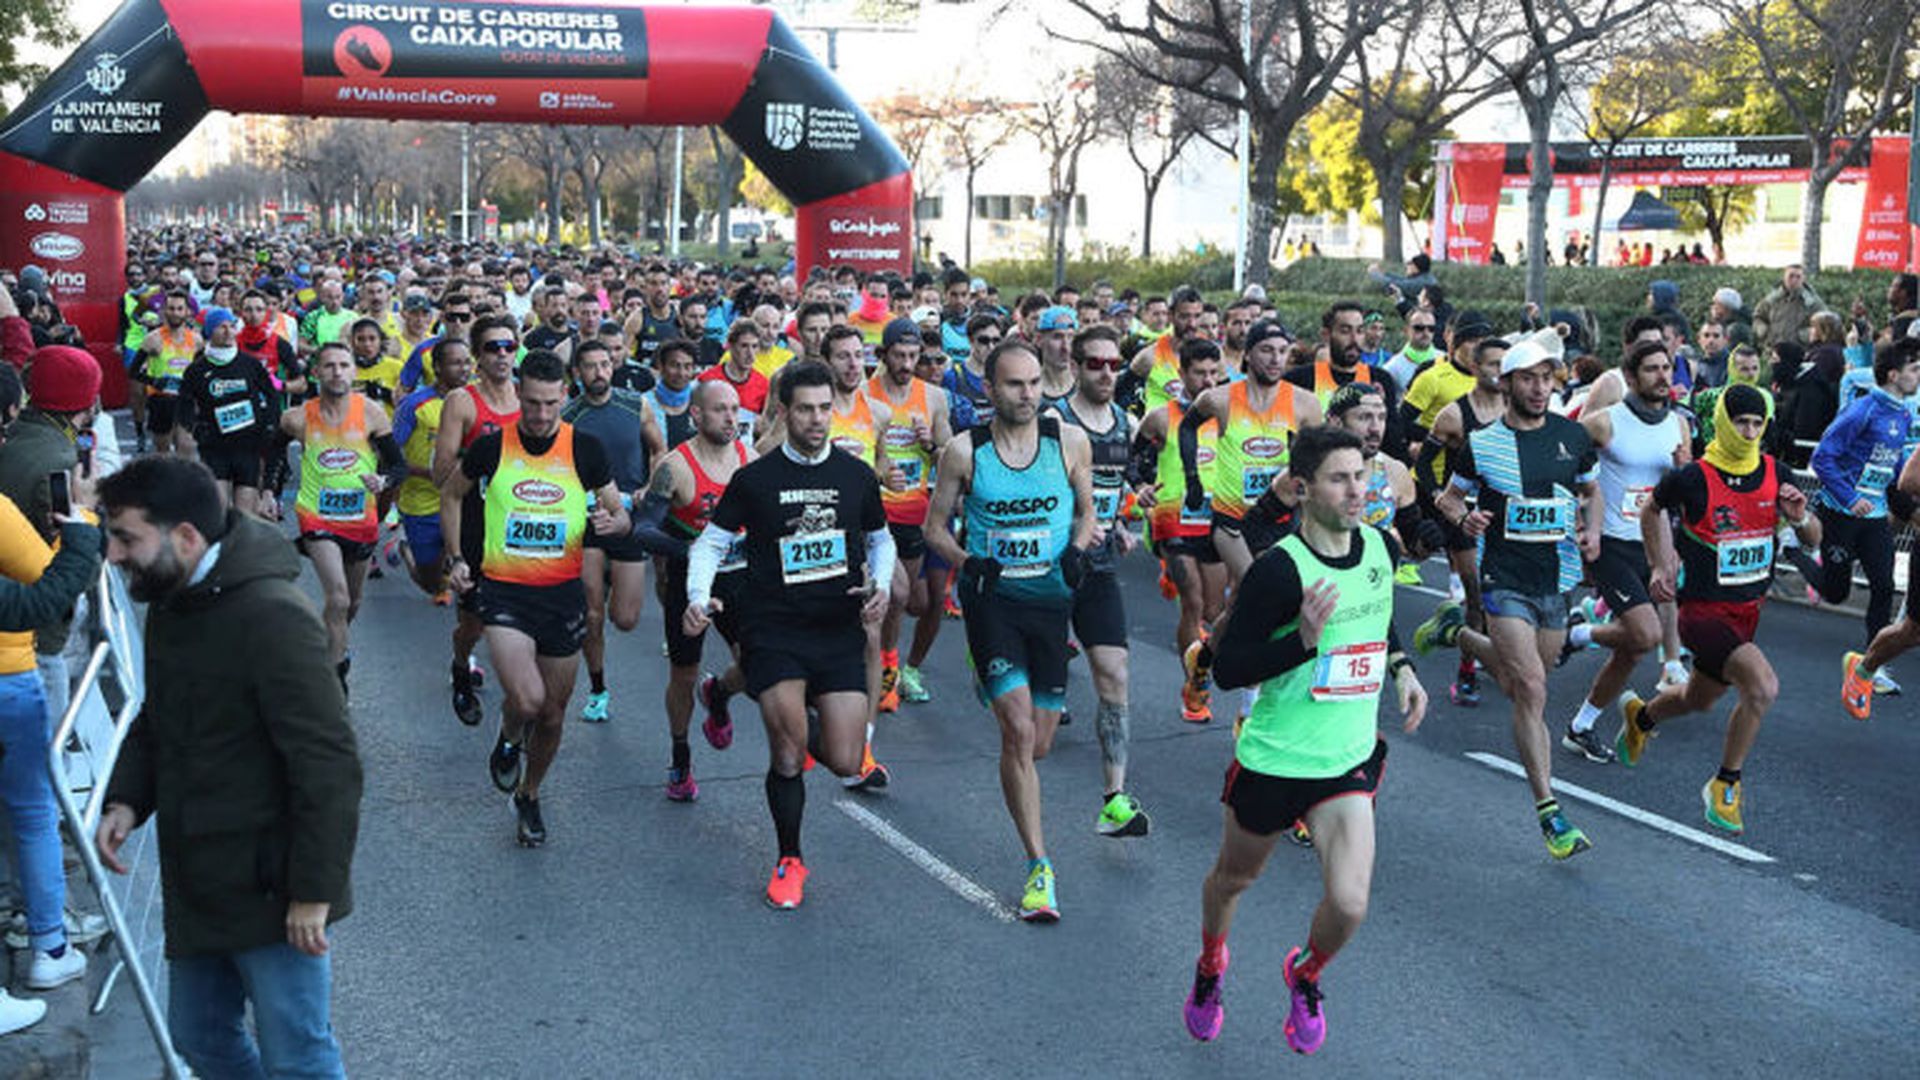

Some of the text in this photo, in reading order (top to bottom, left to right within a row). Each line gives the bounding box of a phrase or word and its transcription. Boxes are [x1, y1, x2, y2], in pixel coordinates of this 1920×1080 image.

[328, 0, 619, 30] CIRCUIT DE CARRERES
[338, 86, 497, 106] #ValènciaCorre
[53, 101, 162, 117] AJUNTAMENT
[52, 116, 162, 133] DE VALÈNCIA
[1645, 143, 1663, 156] DE
[1665, 142, 1737, 156] CARRERES
[984, 496, 1059, 516] CRESPO
[1516, 506, 1557, 524] 2514
[512, 520, 557, 541] 2063
[792, 539, 834, 563] 2132
[997, 539, 1040, 559] 2424
[1348, 657, 1372, 678] 15
